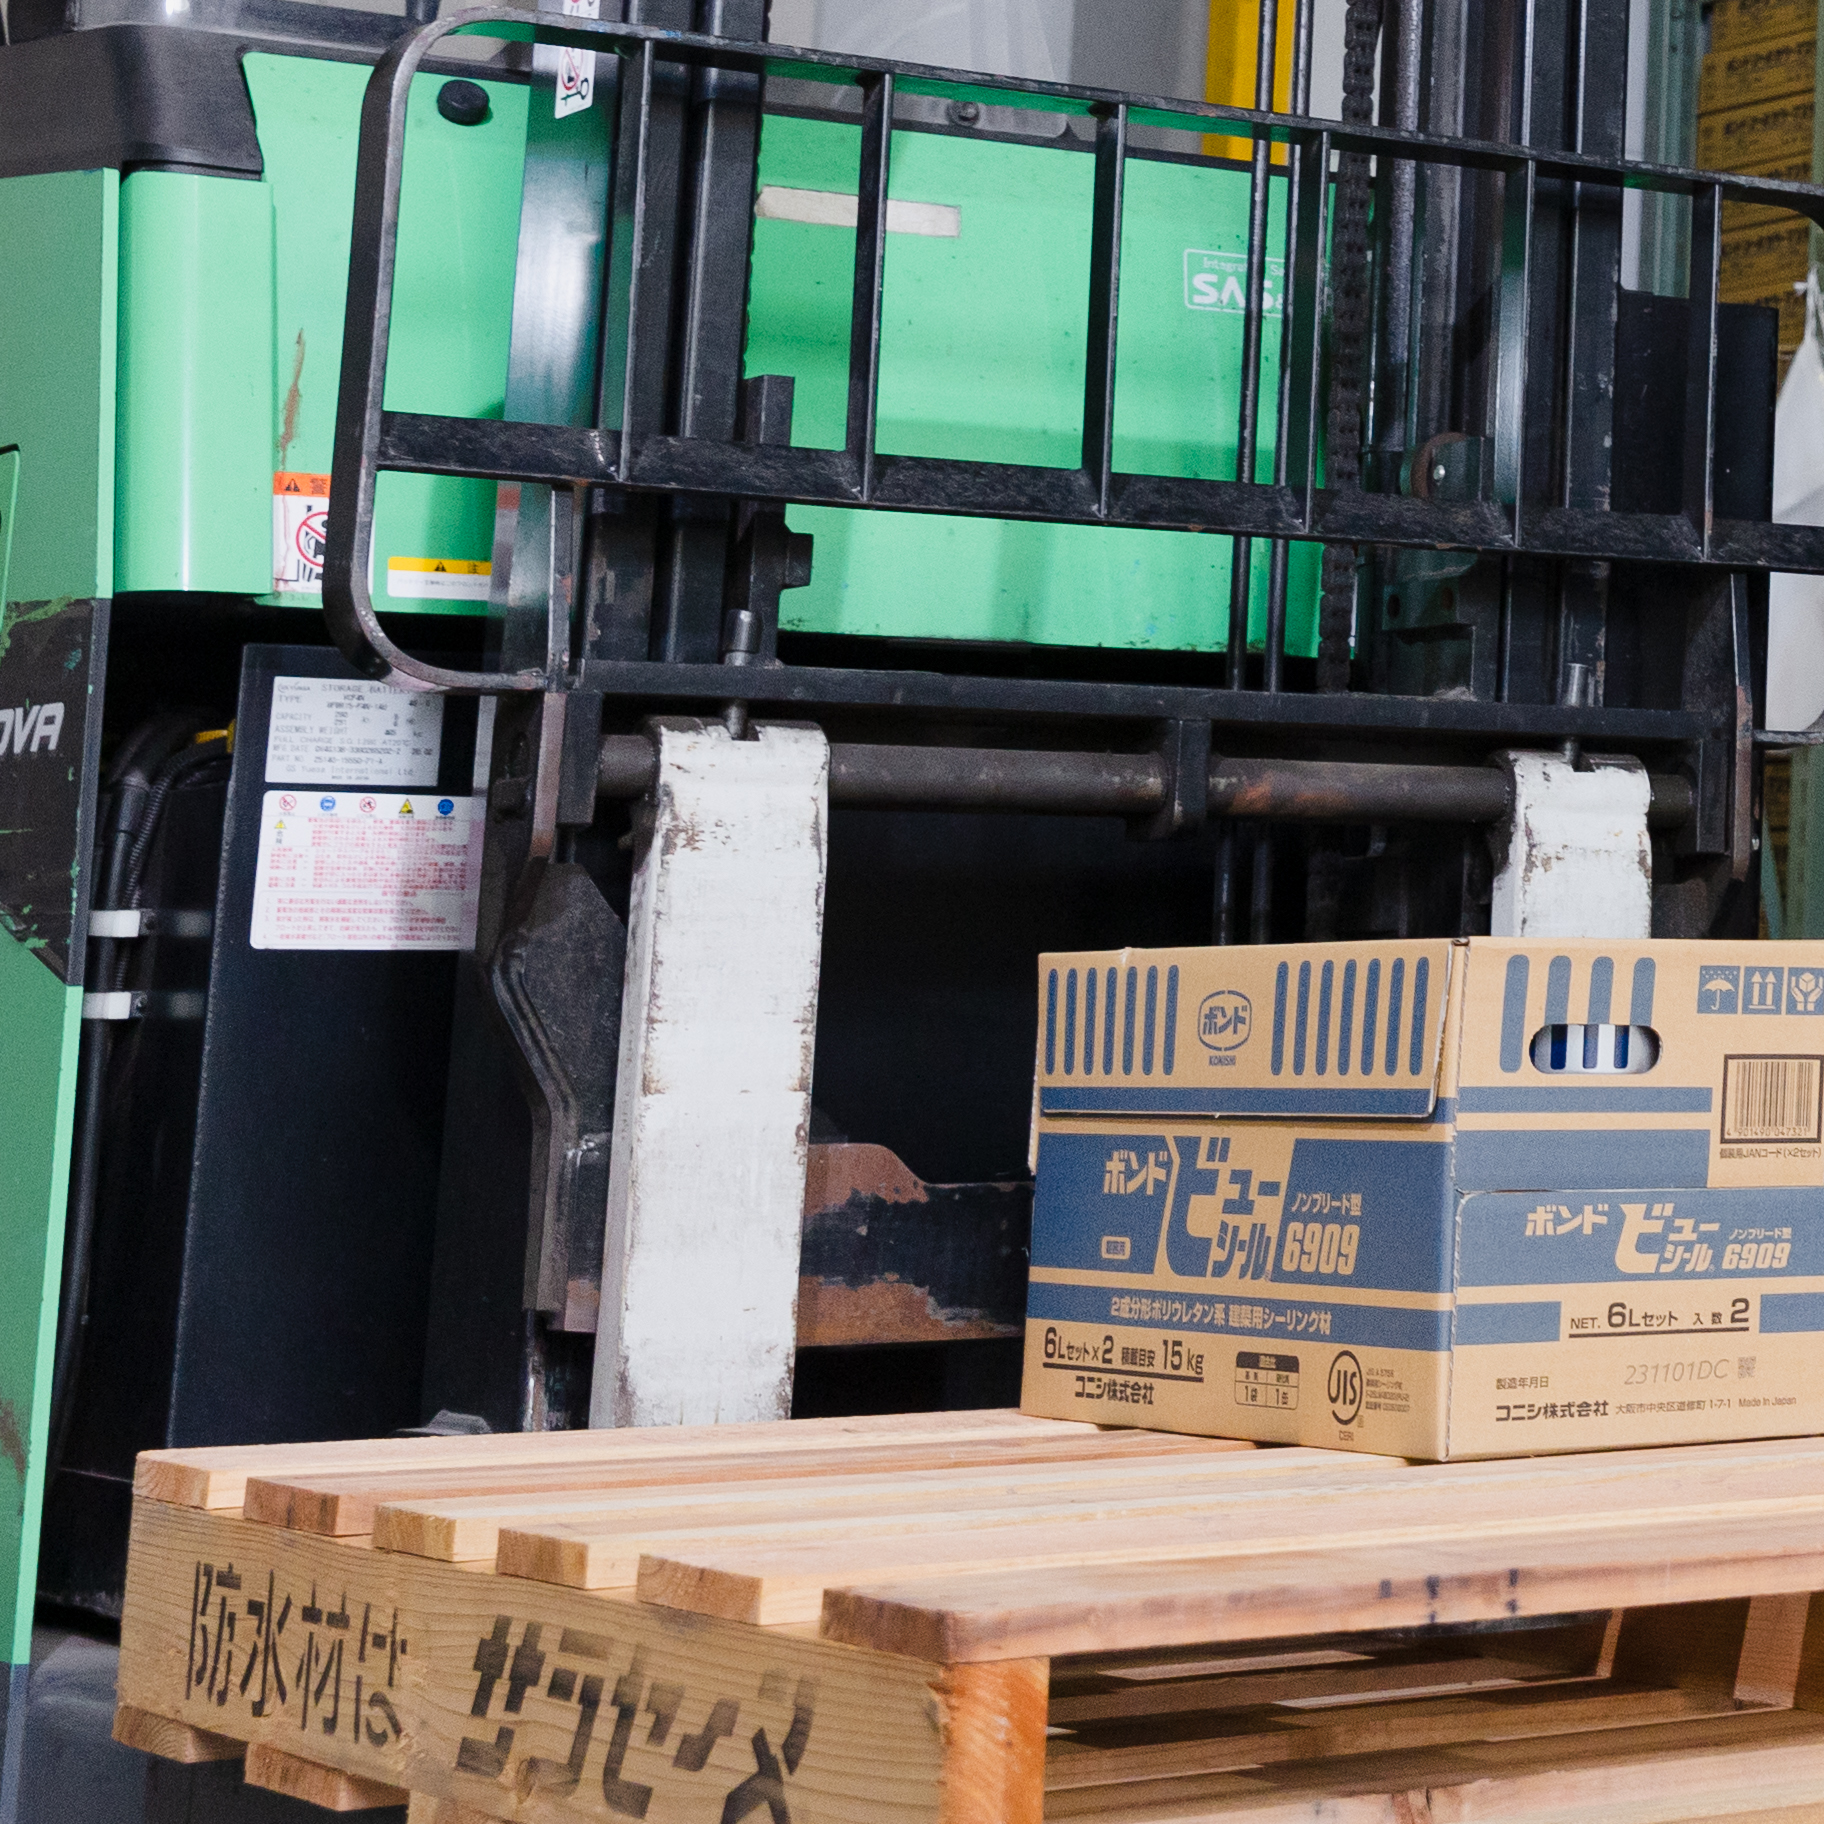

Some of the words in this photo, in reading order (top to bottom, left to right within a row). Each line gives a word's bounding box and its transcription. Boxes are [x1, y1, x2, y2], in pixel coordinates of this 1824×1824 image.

[1203, 1005, 1248, 1036] ボンド
[1209, 1055, 1236, 1066] KONISHI
[1104, 1149, 1168, 1195] ボンド
[1525, 1204, 1608, 1236] ボンド
[1282, 1223, 1360, 1275] 6909
[1722, 1242, 1791, 1271] 6909
[1570, 1317, 1601, 1330] NET.
[1730, 1298, 1750, 1324] 2
[1162, 1339, 1182, 1370] 15
[1187, 1346, 1204, 1375] kg
[1075, 1377, 1154, 1406] コニシ株式会社
[1496, 1376, 1549, 1391] 製造年月日
[1496, 1400, 1609, 1422] コニシ株式会社
